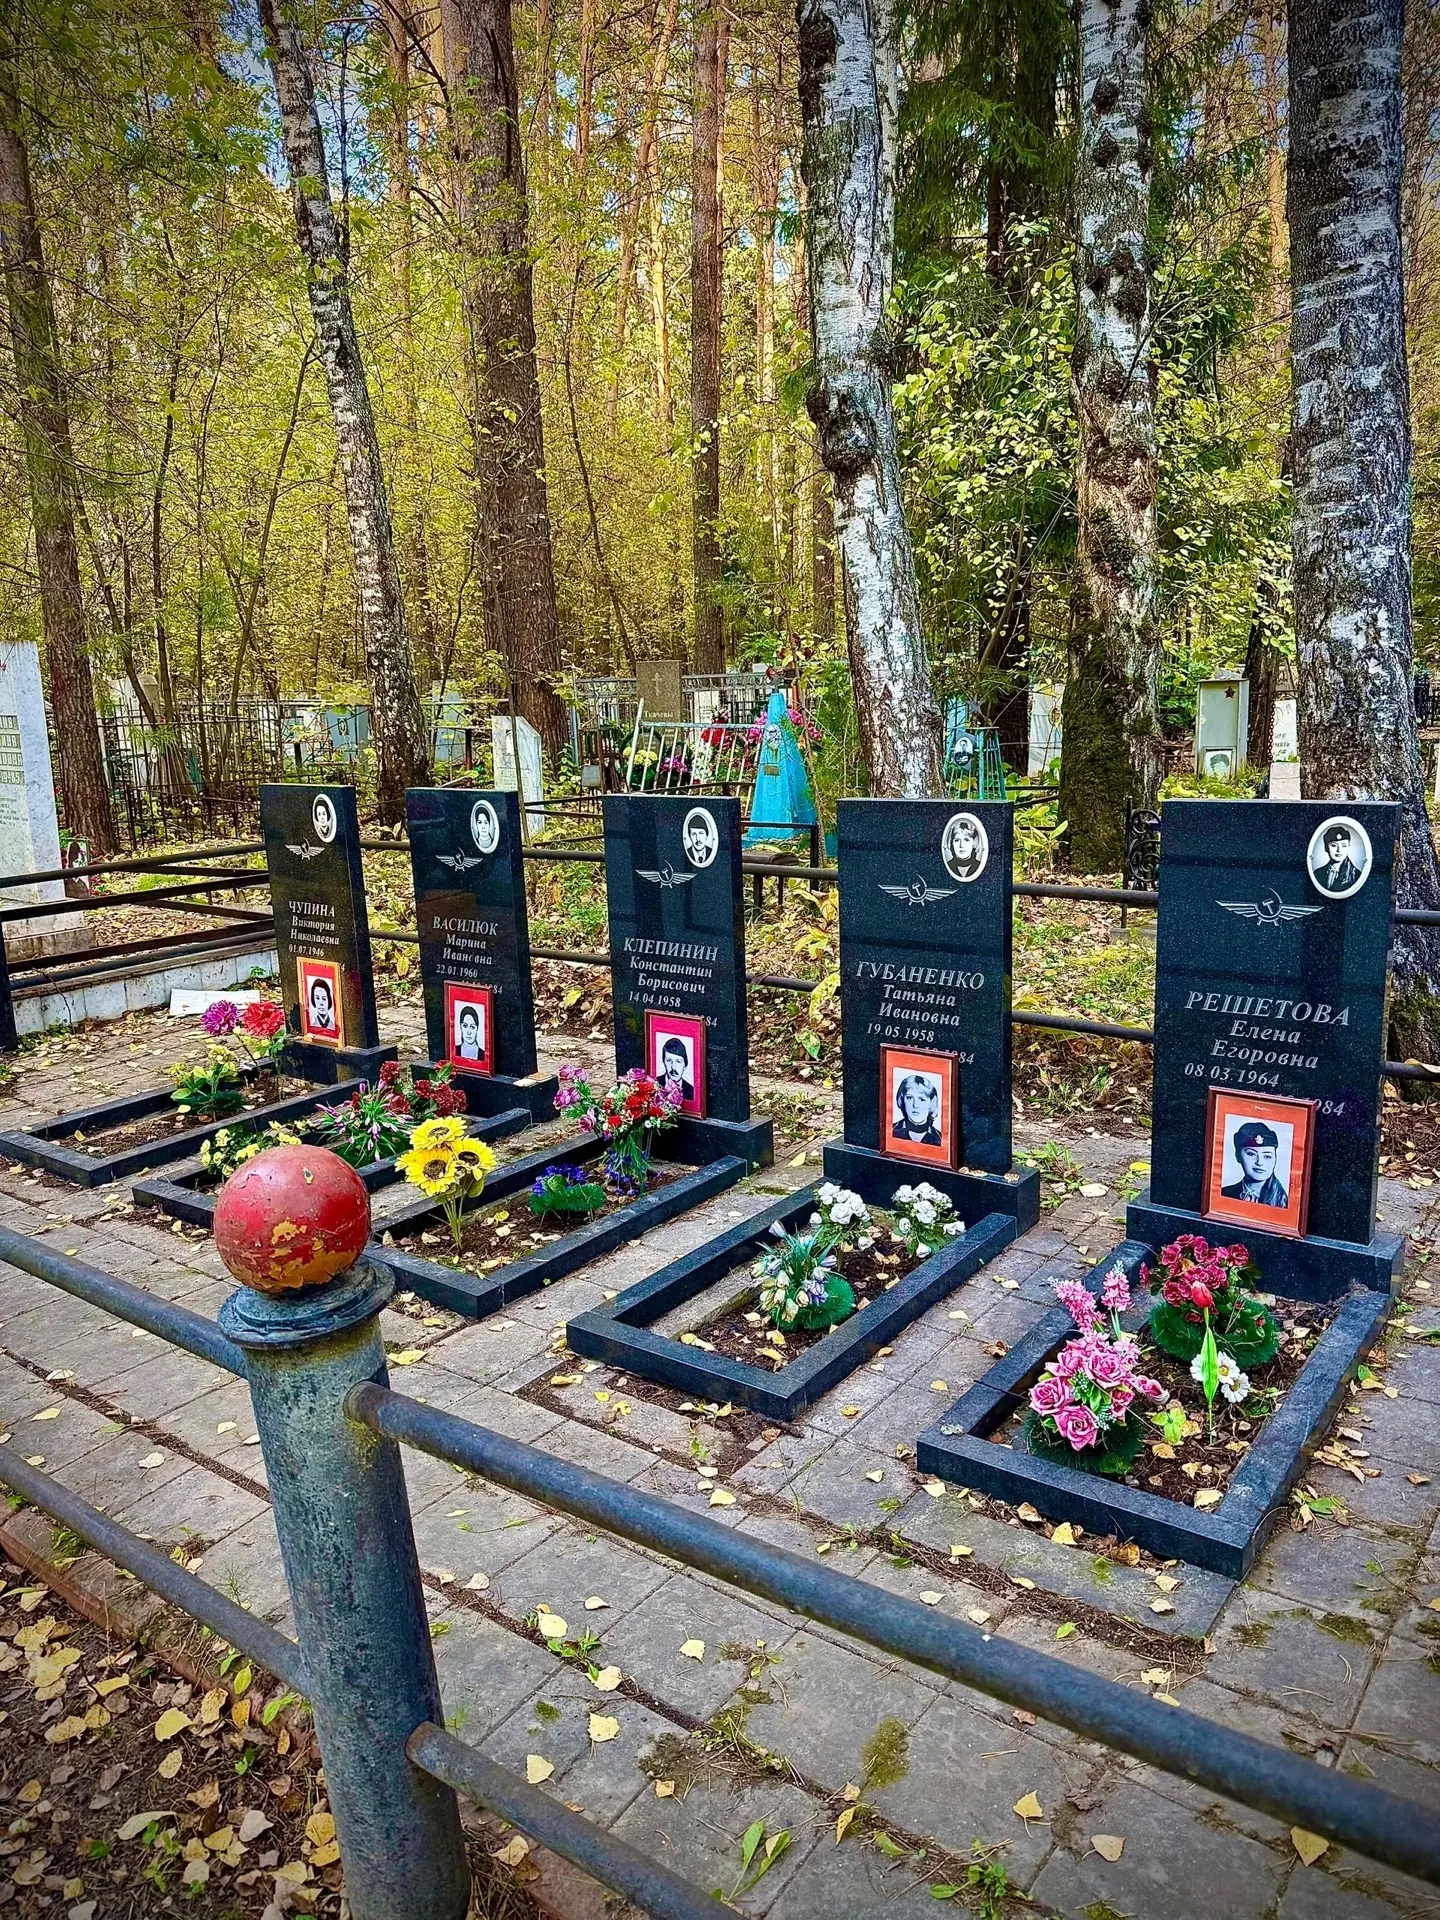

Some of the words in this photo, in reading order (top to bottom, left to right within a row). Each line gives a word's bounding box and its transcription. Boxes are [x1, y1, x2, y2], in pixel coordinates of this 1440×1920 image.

[288, 900, 335, 918] ЧУПИНА
[292, 915, 336, 932] Виктория
[432, 915, 499, 936] ВАСИЛЮК
[290, 928, 340, 946] Николаевна
[445, 933, 487, 950] Марина
[288, 943, 325, 957] 01.07.1946
[623, 936, 719, 961] КЛЕПИНИН
[435, 963, 478, 978] 22.01.1960
[629, 955, 713, 978] Константин
[855, 960, 986, 990] ГУБАНЕНКО
[637, 972, 706, 994] Борисович
[628, 990, 682, 1008] 14.04.1958
[883, 984, 957, 1007] Татьяна
[878, 1002, 961, 1027] Ивановна
[1183, 990, 1351, 1026] РЕШЕТОВА
[867, 1022, 935, 1043] 19.05.1958
[1228, 1019, 1302, 1044] Елена
[1209, 1038, 1320, 1069] Егоровна
[1184, 1061, 1281, 1088] 08.03.1964
